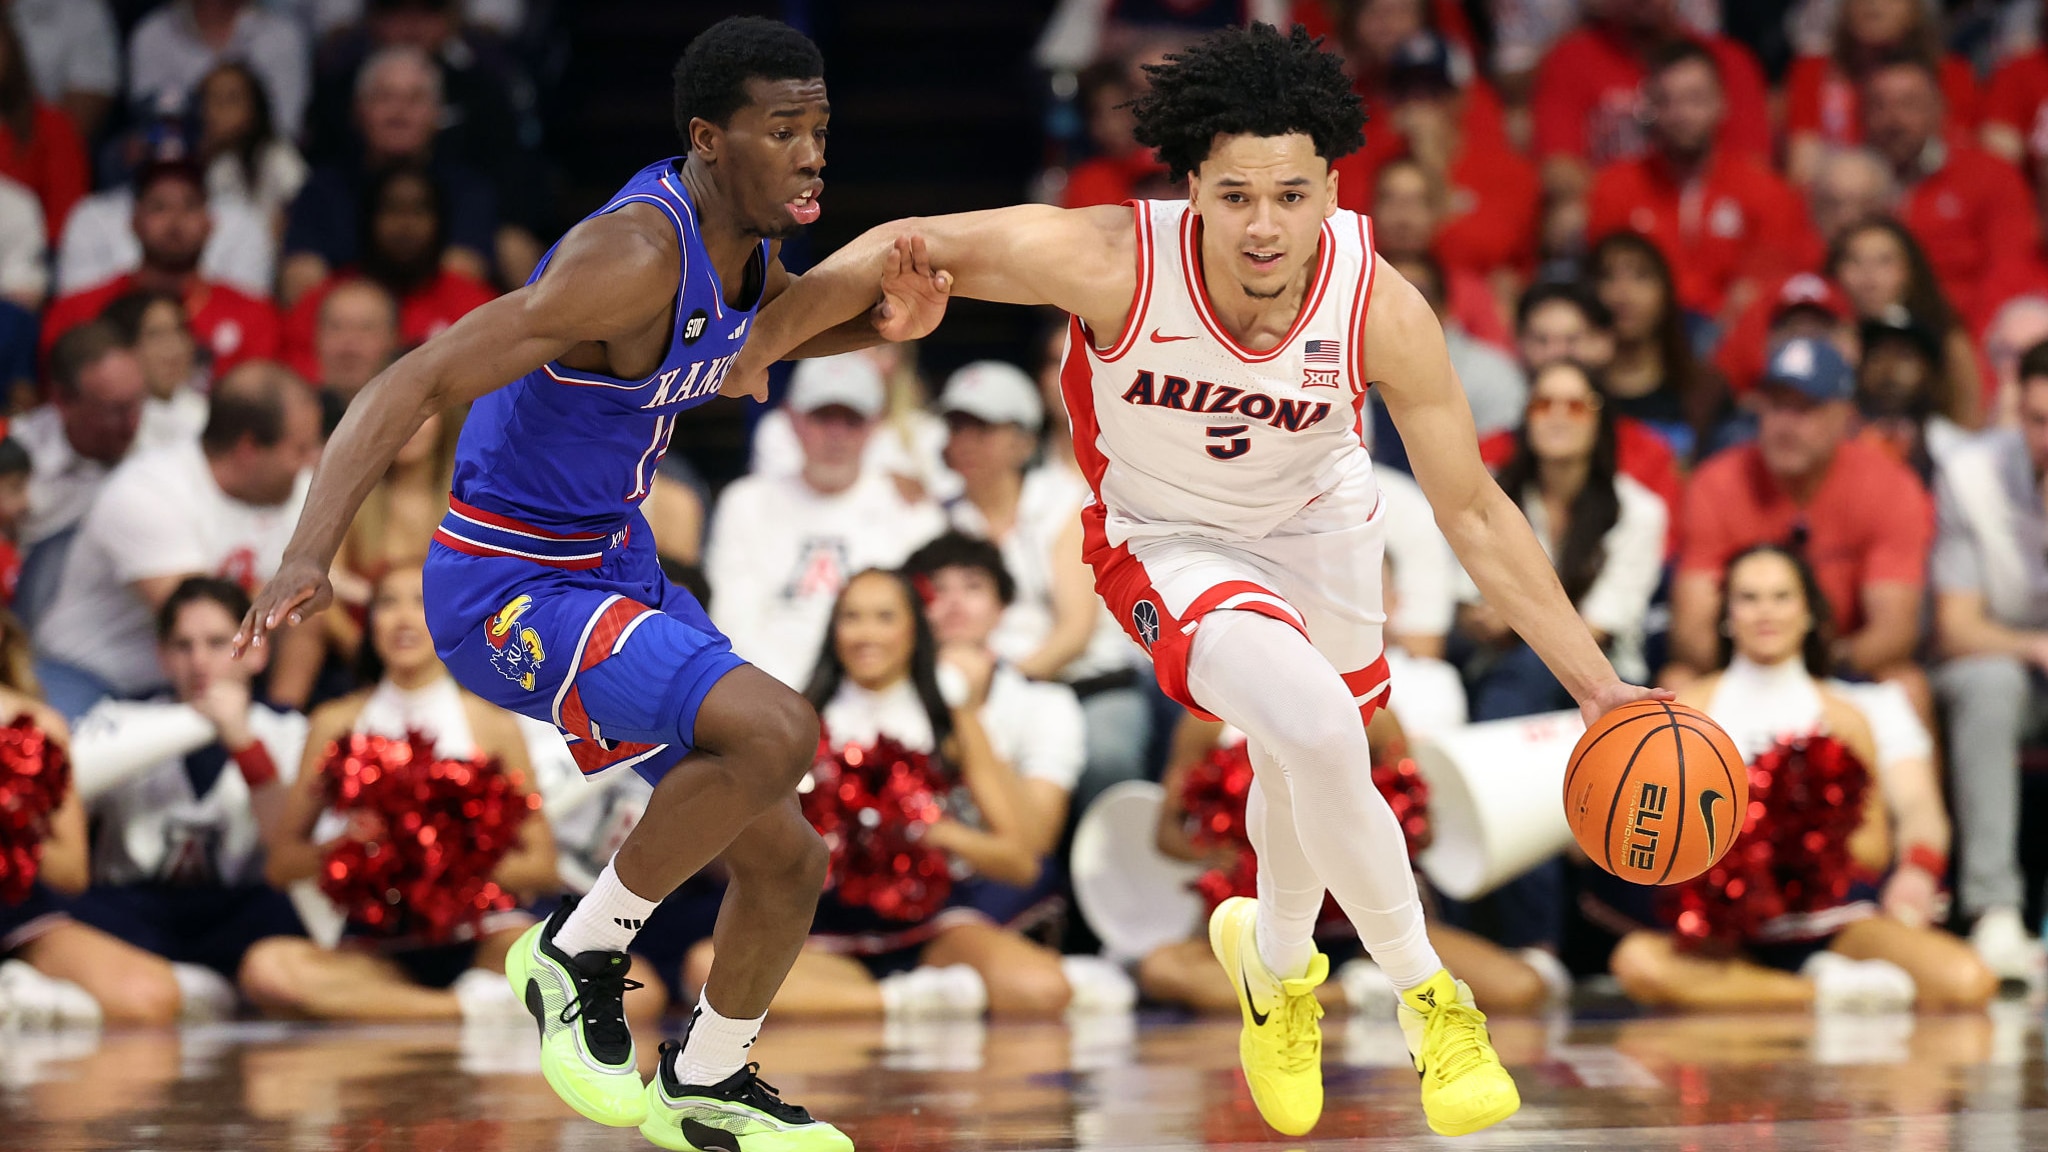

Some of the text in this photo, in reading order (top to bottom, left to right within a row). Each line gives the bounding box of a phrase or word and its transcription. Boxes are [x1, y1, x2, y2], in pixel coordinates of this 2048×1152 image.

[640, 345, 744, 409] KANS
[1121, 369, 1332, 432] ARIZONA
[1205, 425, 1251, 460] 5
[1628, 782, 1668, 871] ELITE
